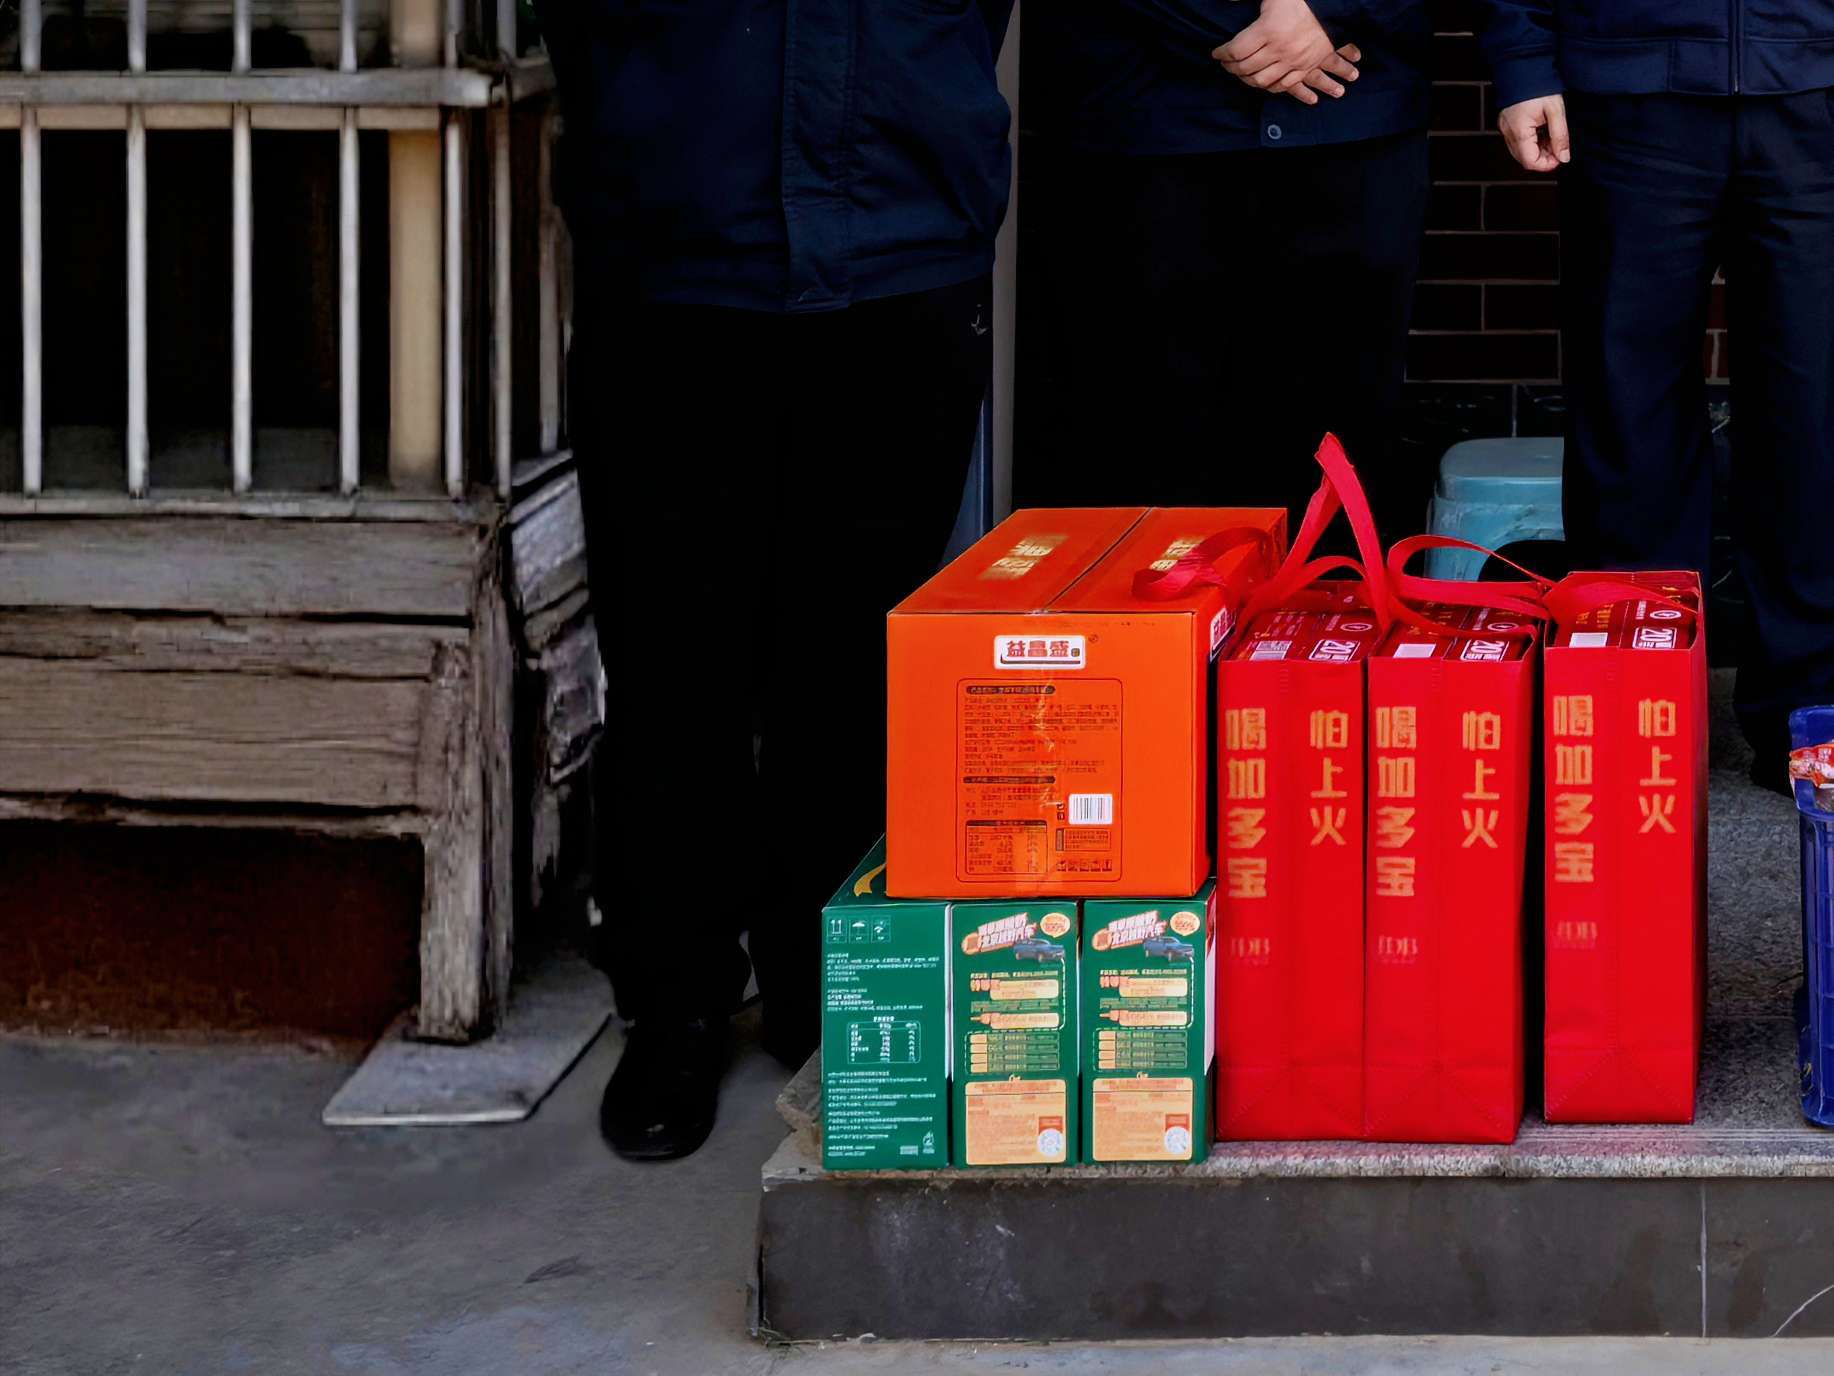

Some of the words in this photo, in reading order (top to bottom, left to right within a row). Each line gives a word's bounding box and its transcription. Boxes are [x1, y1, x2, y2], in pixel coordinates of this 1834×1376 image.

[1225, 708, 1267, 899] 喝加多宝
[1310, 710, 1349, 846] 怕上火
[1375, 706, 1417, 897] 喝加多宝
[1462, 711, 1501, 848] 怕上火
[1553, 695, 1594, 882] 喝加多宝
[1638, 698, 1677, 834] 怕上火
